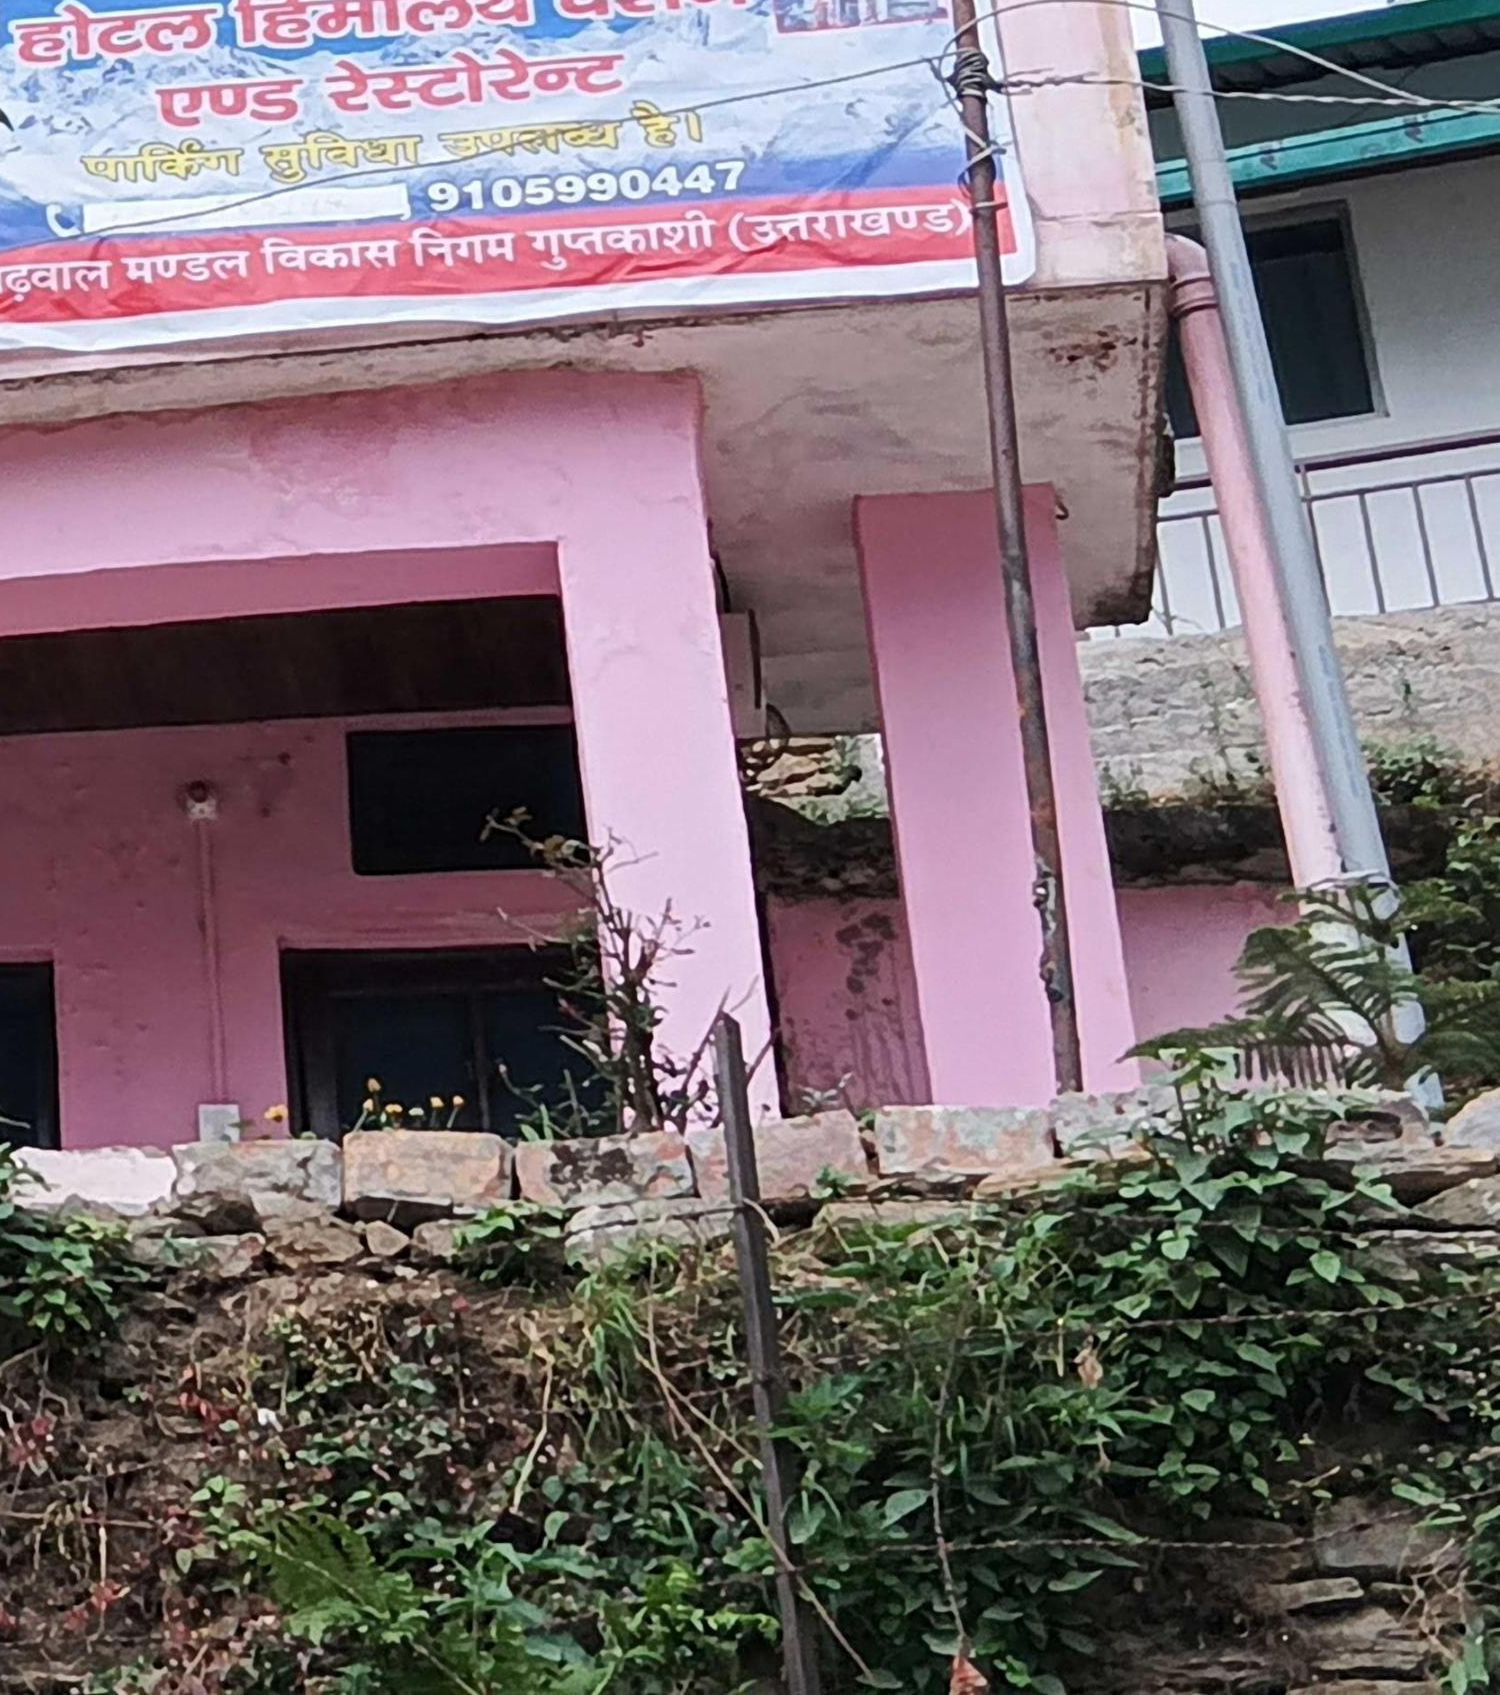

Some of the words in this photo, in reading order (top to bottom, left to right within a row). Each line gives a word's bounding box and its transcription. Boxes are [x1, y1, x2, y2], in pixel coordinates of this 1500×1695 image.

[14, 3, 220, 63] होटल
[154, 78, 305, 127] एण्ड
[323, 47, 626, 114] रेस्टोरेन्ट
[258, 130, 423, 184] सुविधा
[438, 120, 622, 157] उपलब्ध
[427, 161, 746, 212] 9105990447
[119, 250, 252, 284] मण्डल
[260, 237, 401, 275] विकास
[408, 226, 516, 267] निगम
[525, 210, 718, 272] गुप्तकाशी
[727, 198, 973, 253] (उत्तराखण्ड)
